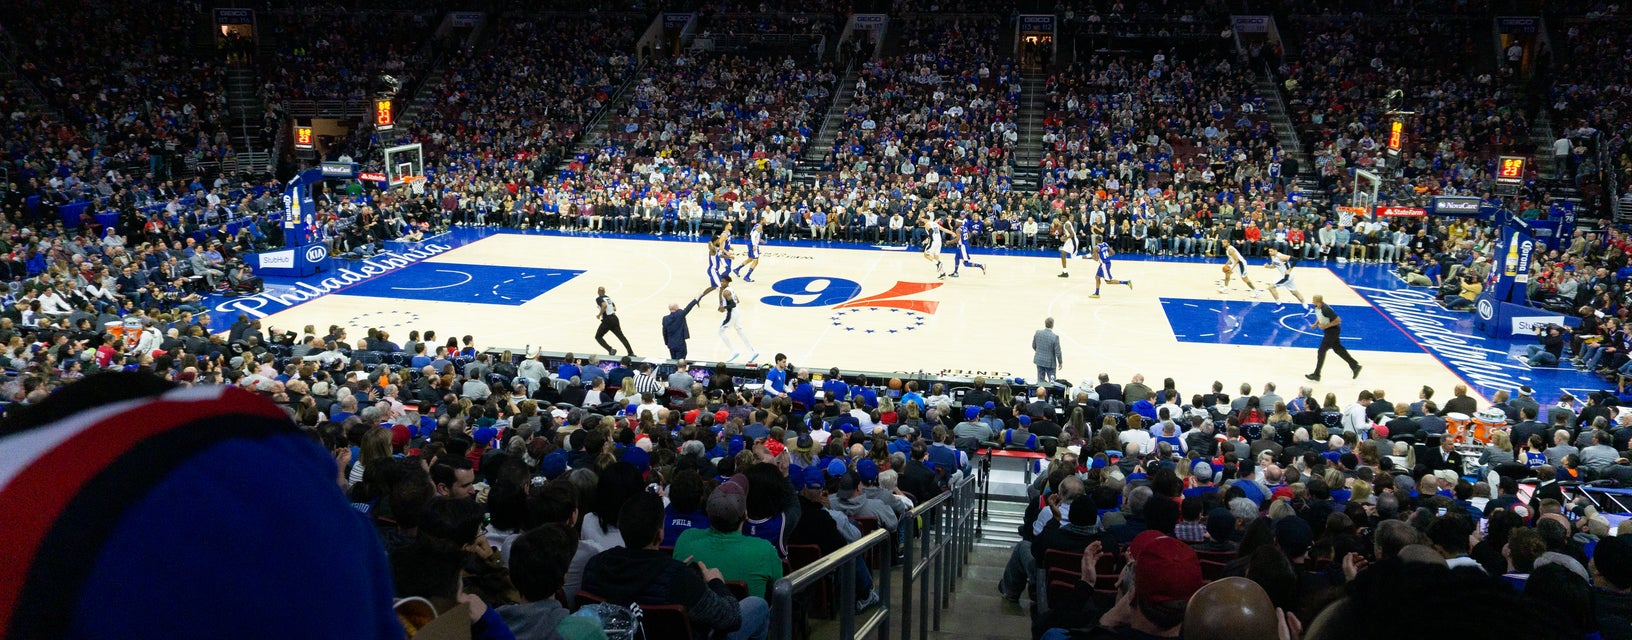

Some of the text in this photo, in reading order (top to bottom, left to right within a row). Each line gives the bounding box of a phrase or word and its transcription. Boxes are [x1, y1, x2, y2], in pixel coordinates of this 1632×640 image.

[378, 110, 390, 124] 23
[298, 135, 310, 143] 23
[1390, 132, 1400, 147] 23
[1503, 166, 1518, 176] 23
[283, 195, 292, 221] Corona
[1446, 202, 1478, 211] NovaCare
[263, 256, 290, 264] StubHub
[308, 248, 325, 260] KIA
[1519, 240, 1533, 272] Corona
[215, 241, 452, 318] Philadelphia
